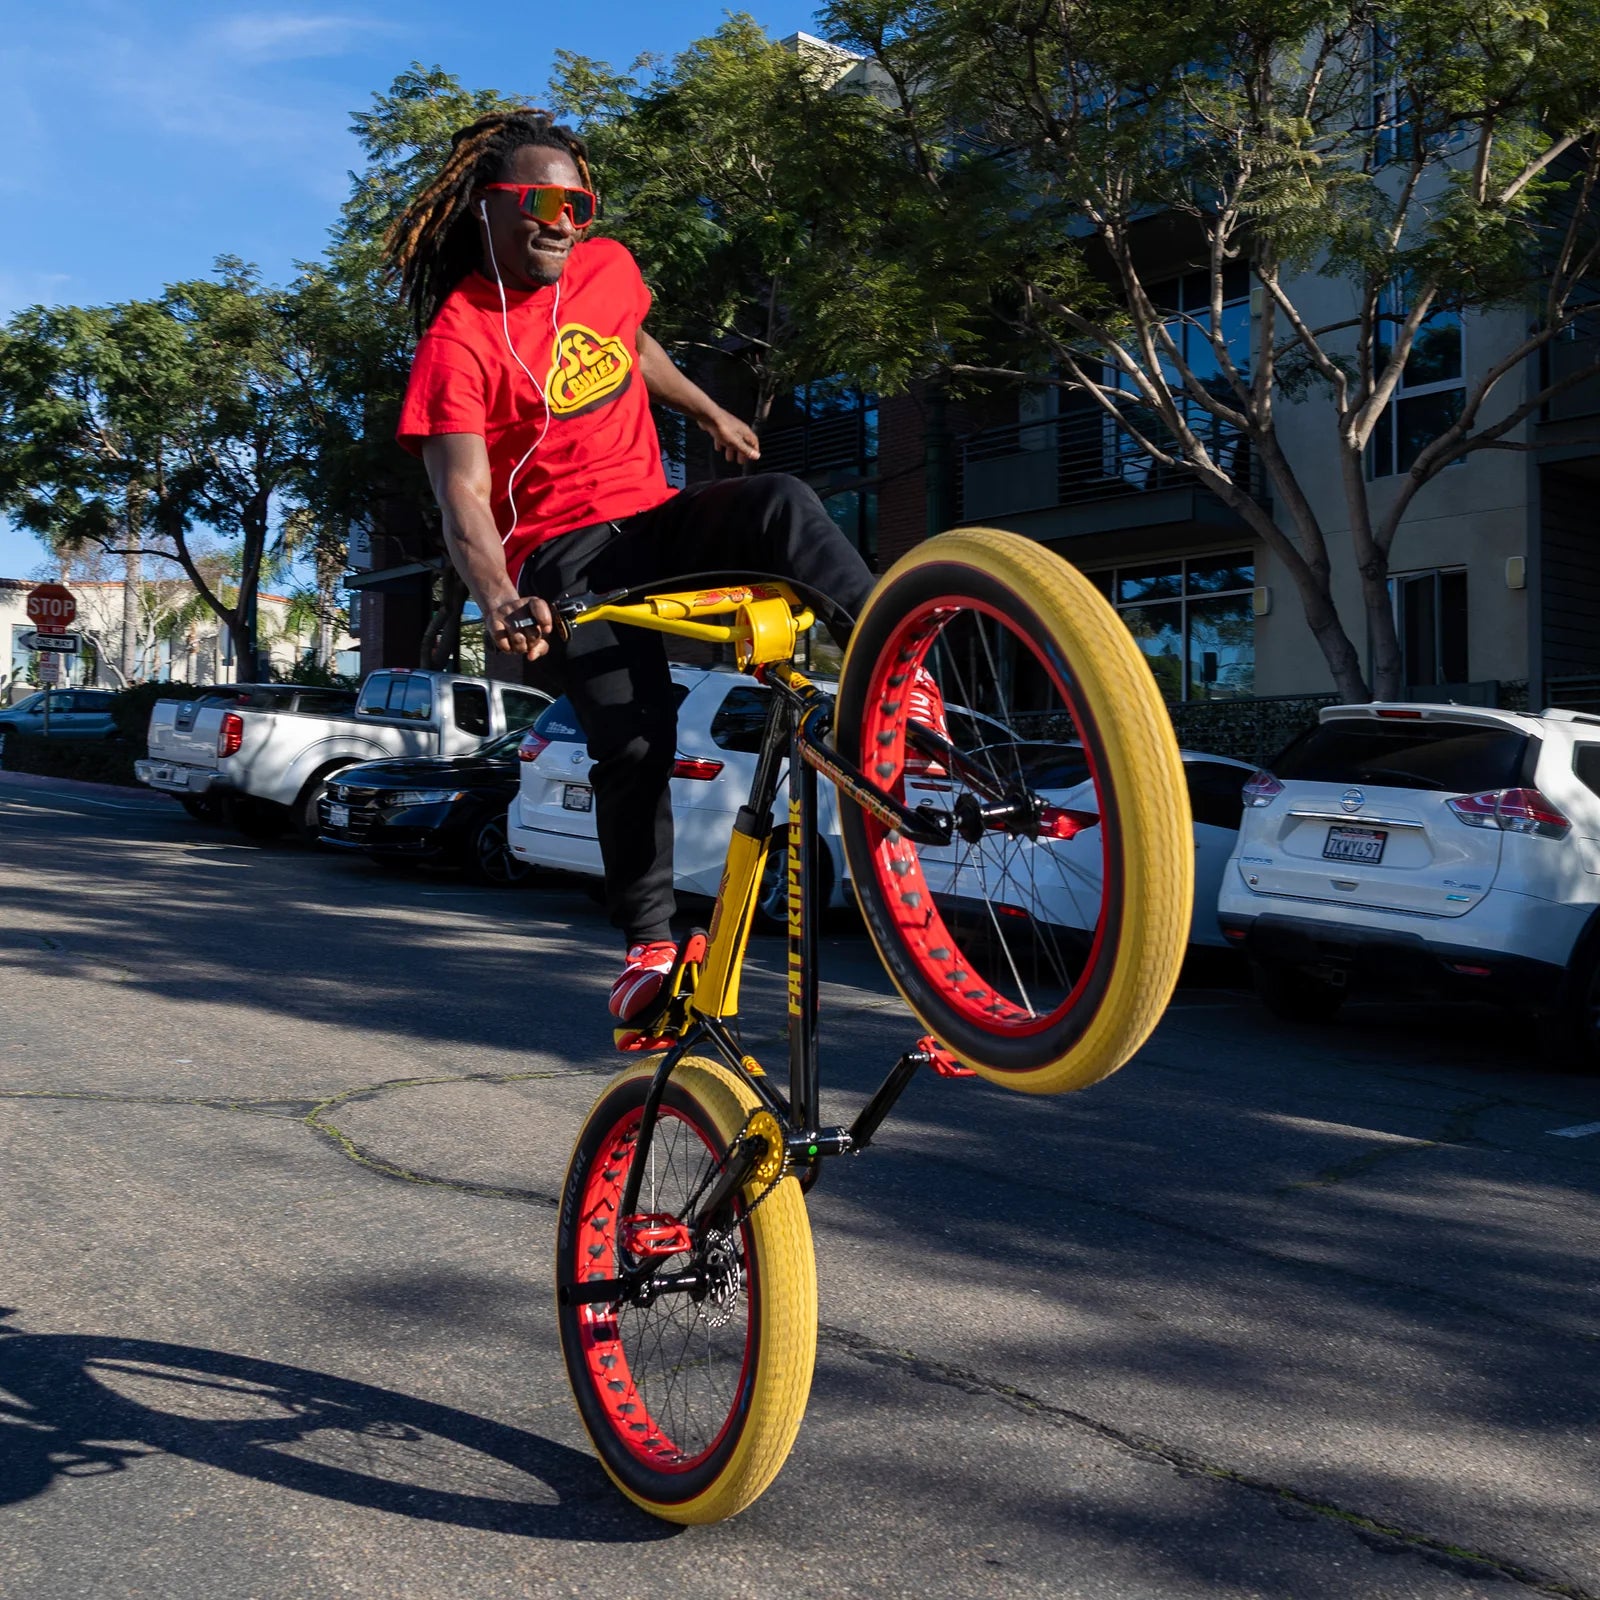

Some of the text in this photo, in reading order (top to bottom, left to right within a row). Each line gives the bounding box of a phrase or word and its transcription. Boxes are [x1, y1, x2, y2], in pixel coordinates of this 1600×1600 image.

[560, 333, 607, 379] SE
[567, 355, 615, 397] BIKES
[28, 598, 74, 617] STOP
[35, 637, 73, 648] ONE WAY
[562, 1149, 587, 1225] CHICANE
